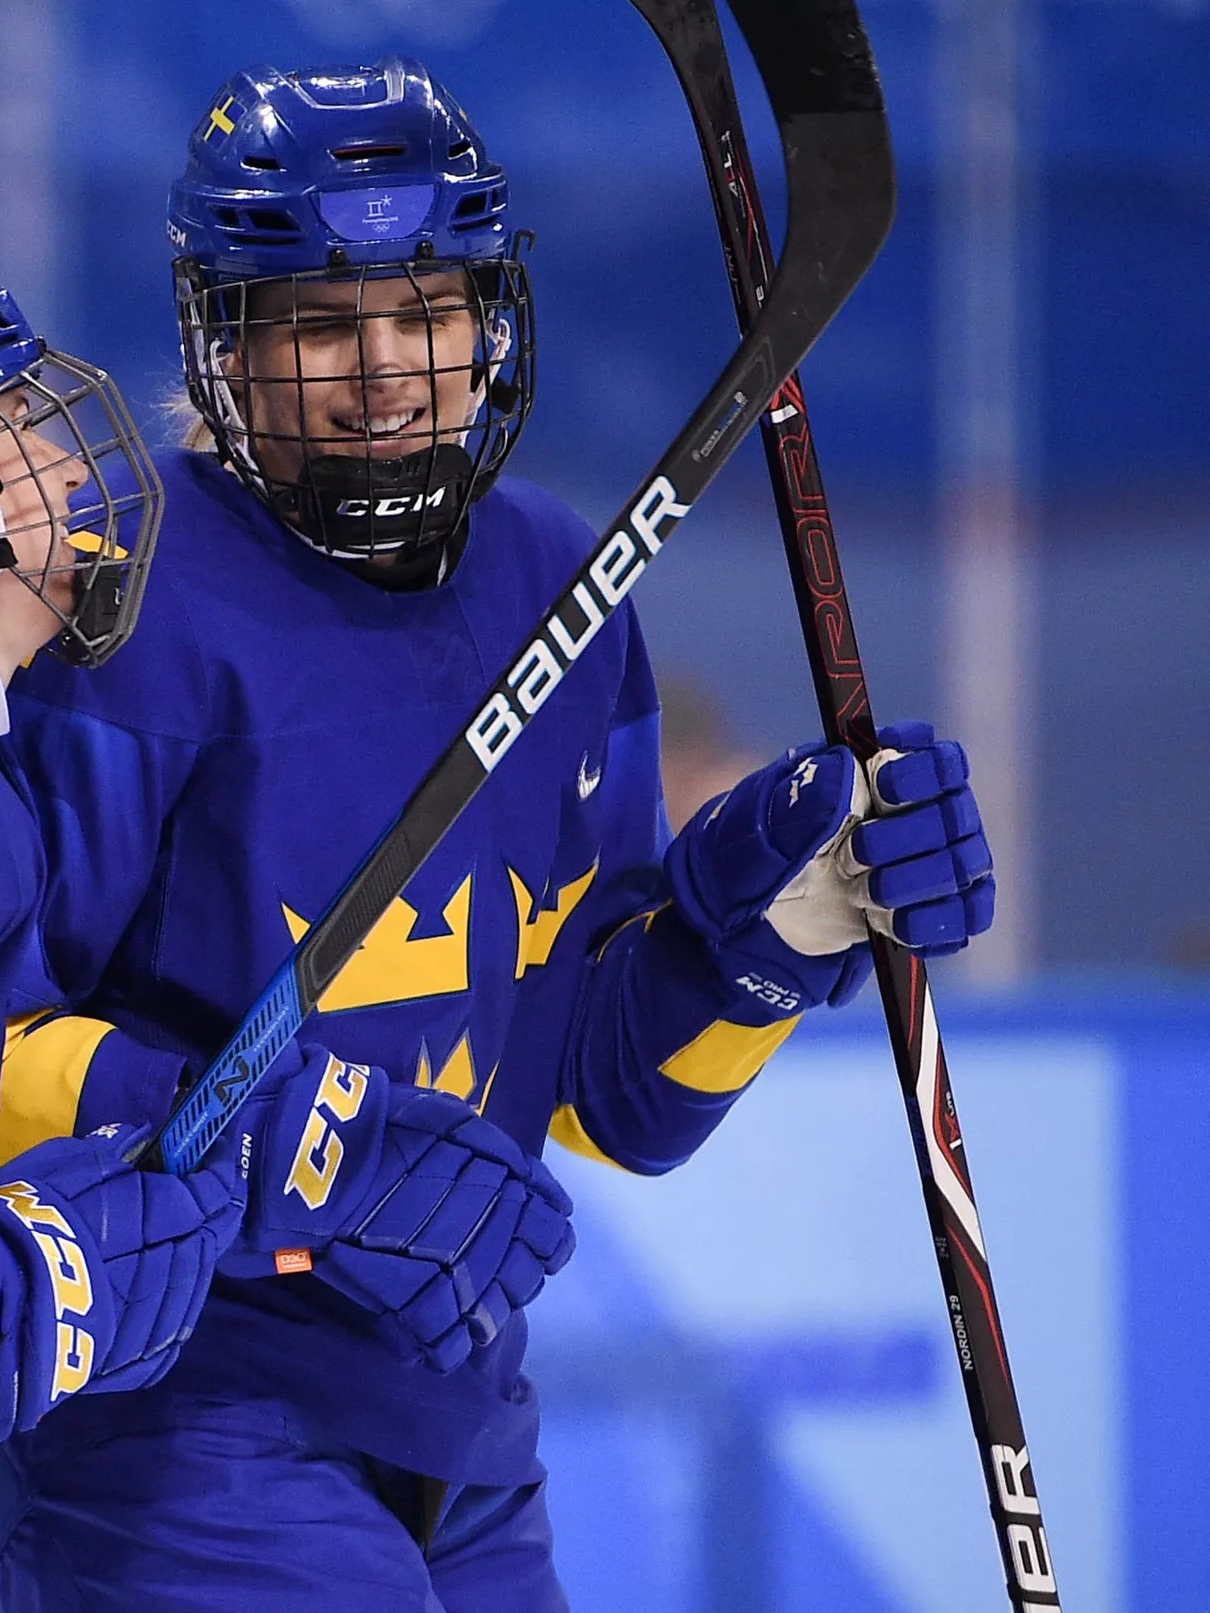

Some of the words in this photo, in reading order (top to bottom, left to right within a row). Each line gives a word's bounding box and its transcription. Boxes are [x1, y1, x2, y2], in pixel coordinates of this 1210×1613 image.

[336, 486, 446, 516] CCM
[736, 976, 798, 1010] CCM
[284, 1051, 370, 1210] CC
[949, 1294, 961, 1311] 29
[954, 1314, 974, 1370] NORDIN
